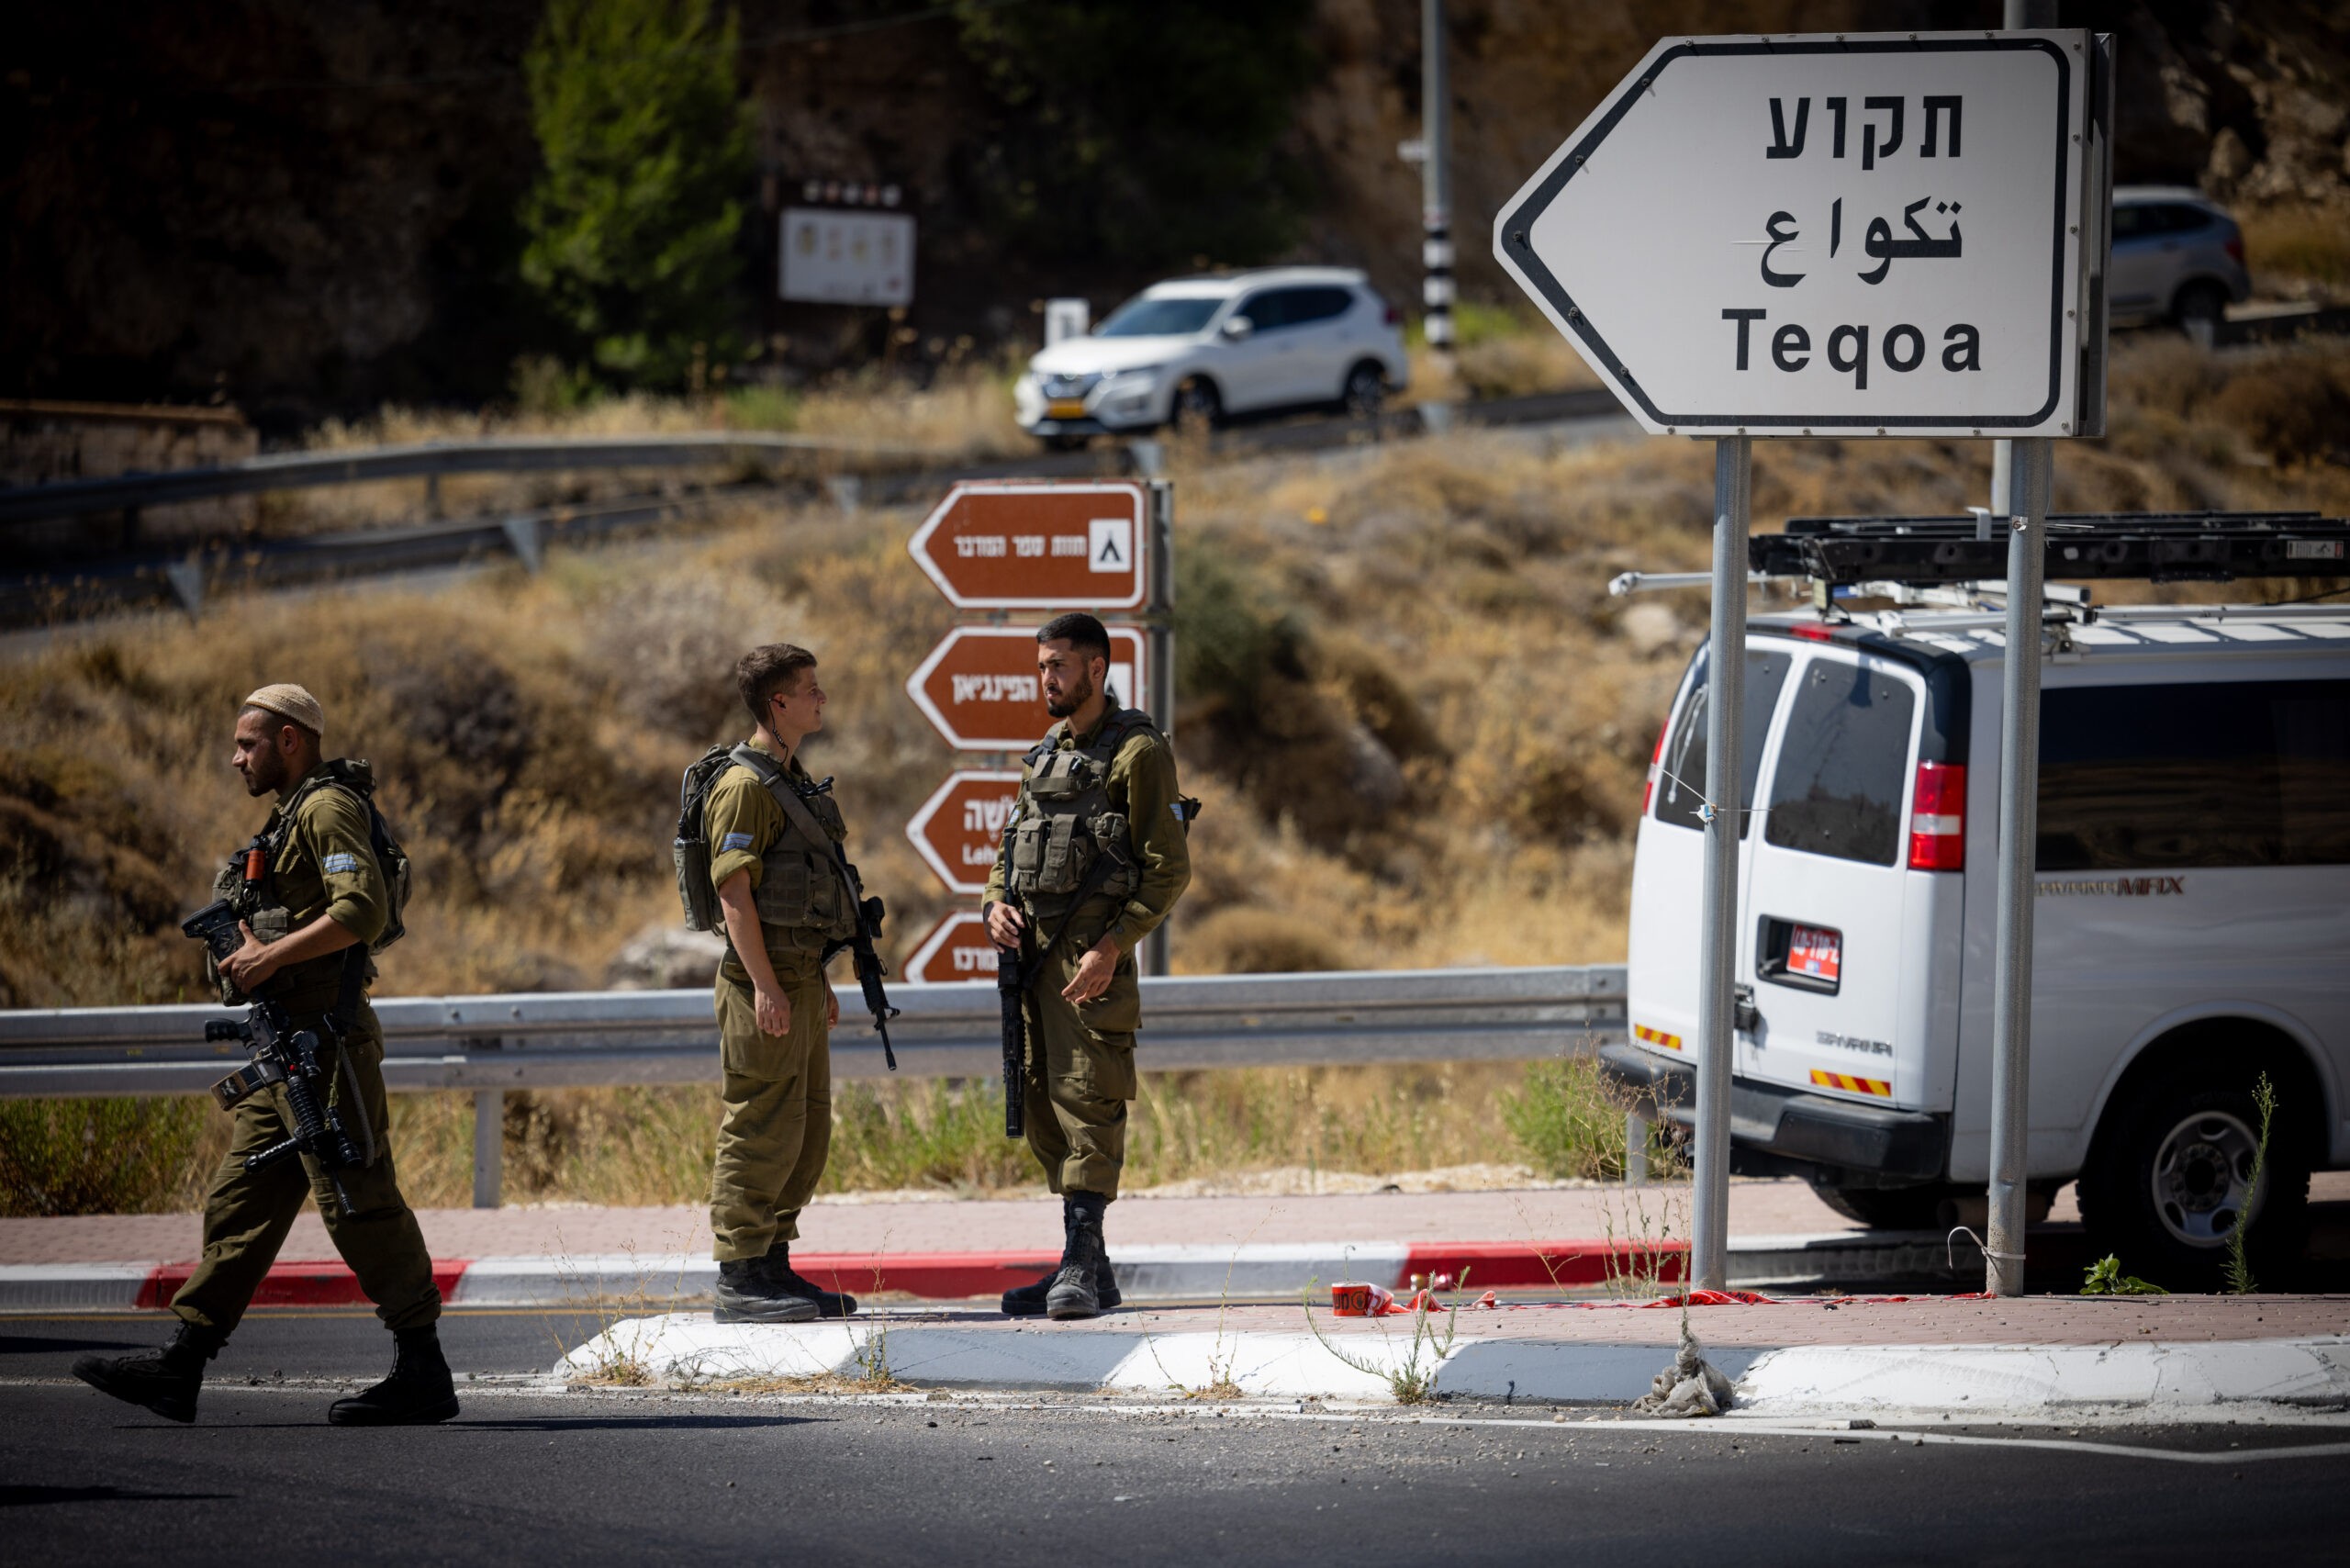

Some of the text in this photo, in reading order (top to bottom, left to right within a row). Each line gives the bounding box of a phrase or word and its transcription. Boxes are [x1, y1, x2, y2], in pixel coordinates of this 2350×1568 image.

[1767, 95, 1963, 170] תקוע
[1762, 196, 1962, 287] تكواع
[1722, 309, 1981, 389] Teqoa
[955, 536, 1006, 556] המדבר
